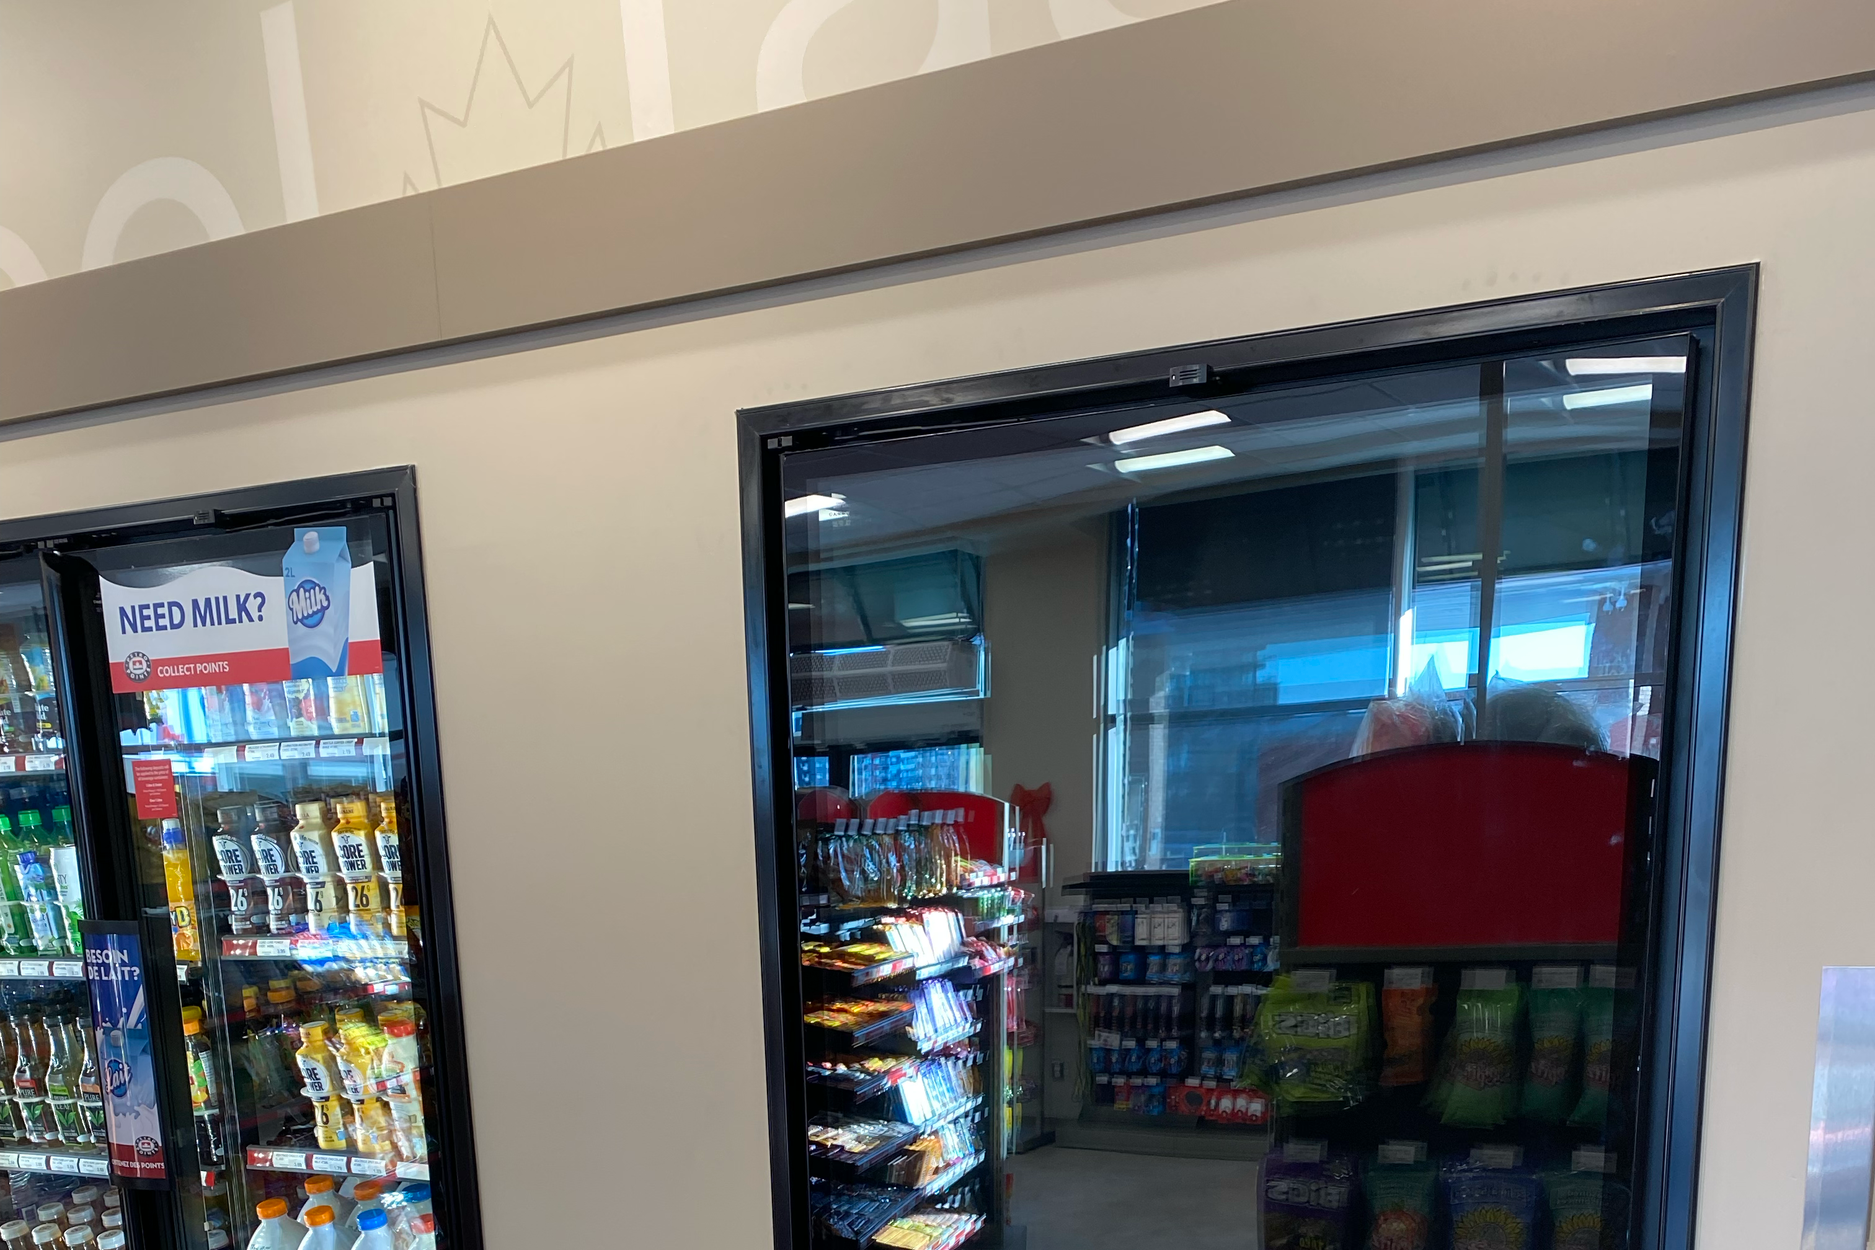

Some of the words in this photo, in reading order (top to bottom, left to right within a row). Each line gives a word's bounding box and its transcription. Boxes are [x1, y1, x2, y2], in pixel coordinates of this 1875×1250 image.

[284, 567, 296, 578] 2L
[289, 585, 329, 622] Milk
[118, 600, 186, 635] NEED
[191, 590, 266, 628] MILK?
[157, 663, 195, 678] COLLECT
[196, 661, 230, 675] POINTS
[85, 949, 129, 964] BESOIN
[87, 965, 100, 980] DE
[100, 966, 140, 981] LAIT?
[105, 1061, 132, 1092] Lait
